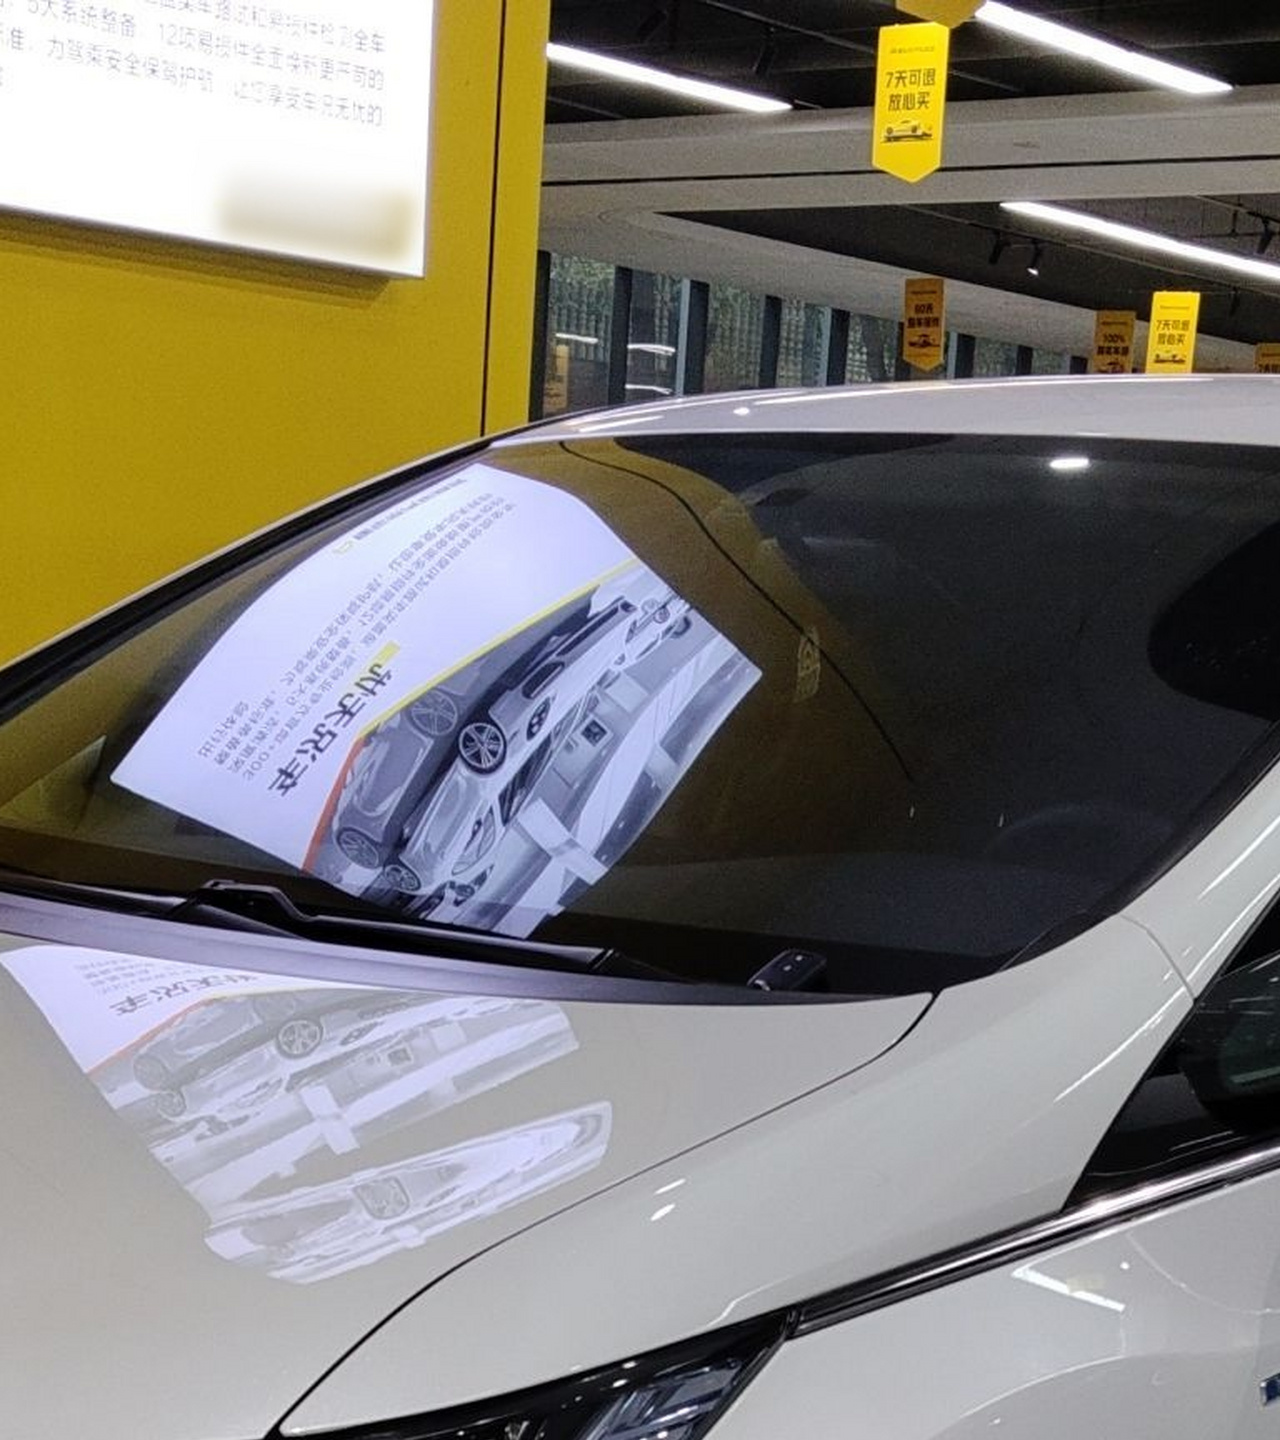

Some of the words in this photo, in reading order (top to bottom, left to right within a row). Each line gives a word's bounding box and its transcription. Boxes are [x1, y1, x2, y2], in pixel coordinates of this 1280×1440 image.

[885, 68, 936, 88] 7天可退
[888, 92, 931, 112] 放心买
[1155, 319, 1190, 332] 7天可退
[1156, 333, 1186, 346] 放心买
